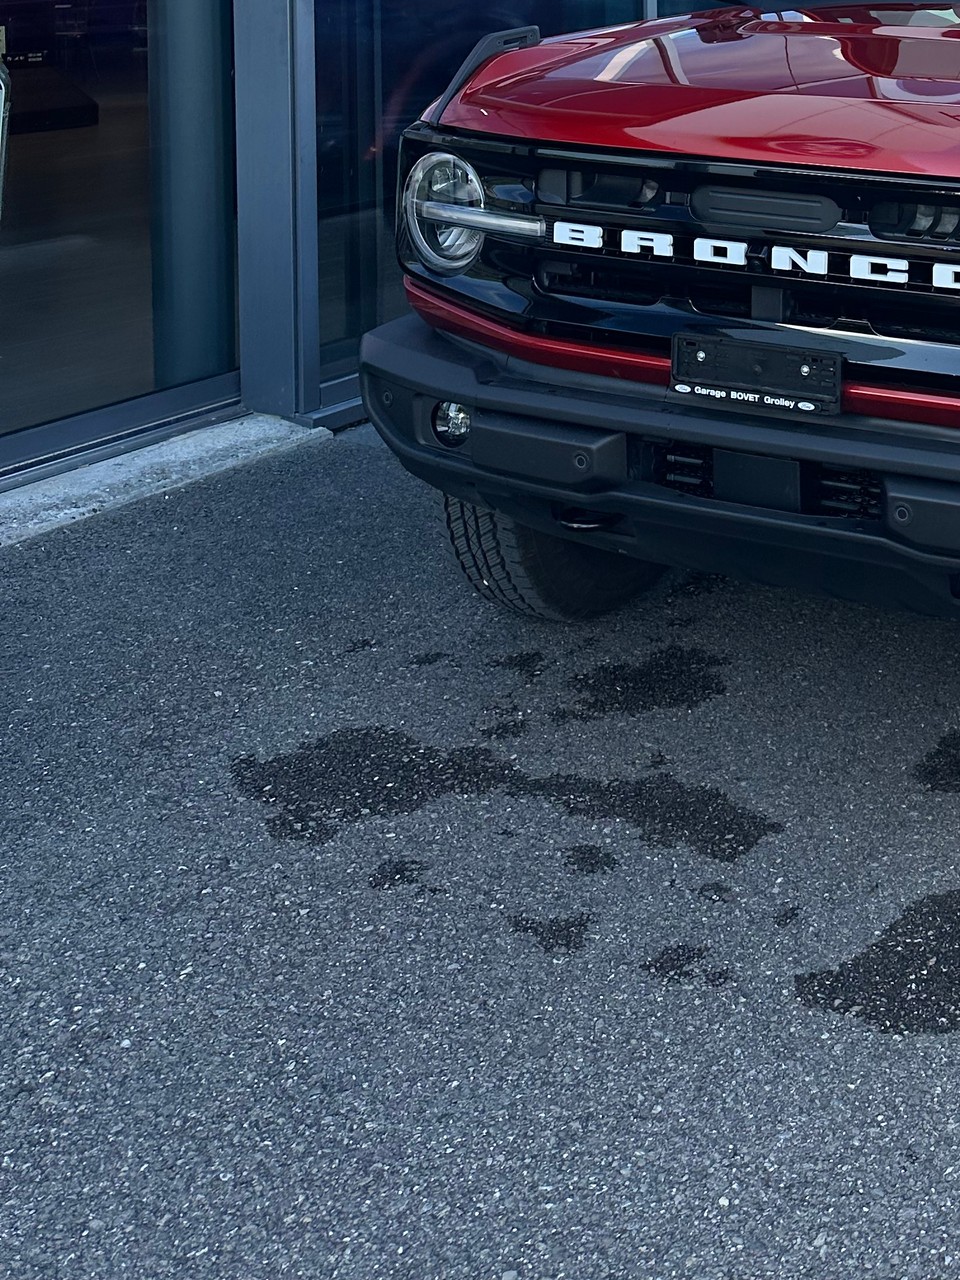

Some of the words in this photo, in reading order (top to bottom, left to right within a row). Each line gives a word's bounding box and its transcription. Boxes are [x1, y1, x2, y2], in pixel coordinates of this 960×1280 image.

[694, 386, 727, 399] Garage
[730, 391, 760, 403] BOVET
[763, 395, 795, 409] Grolley
